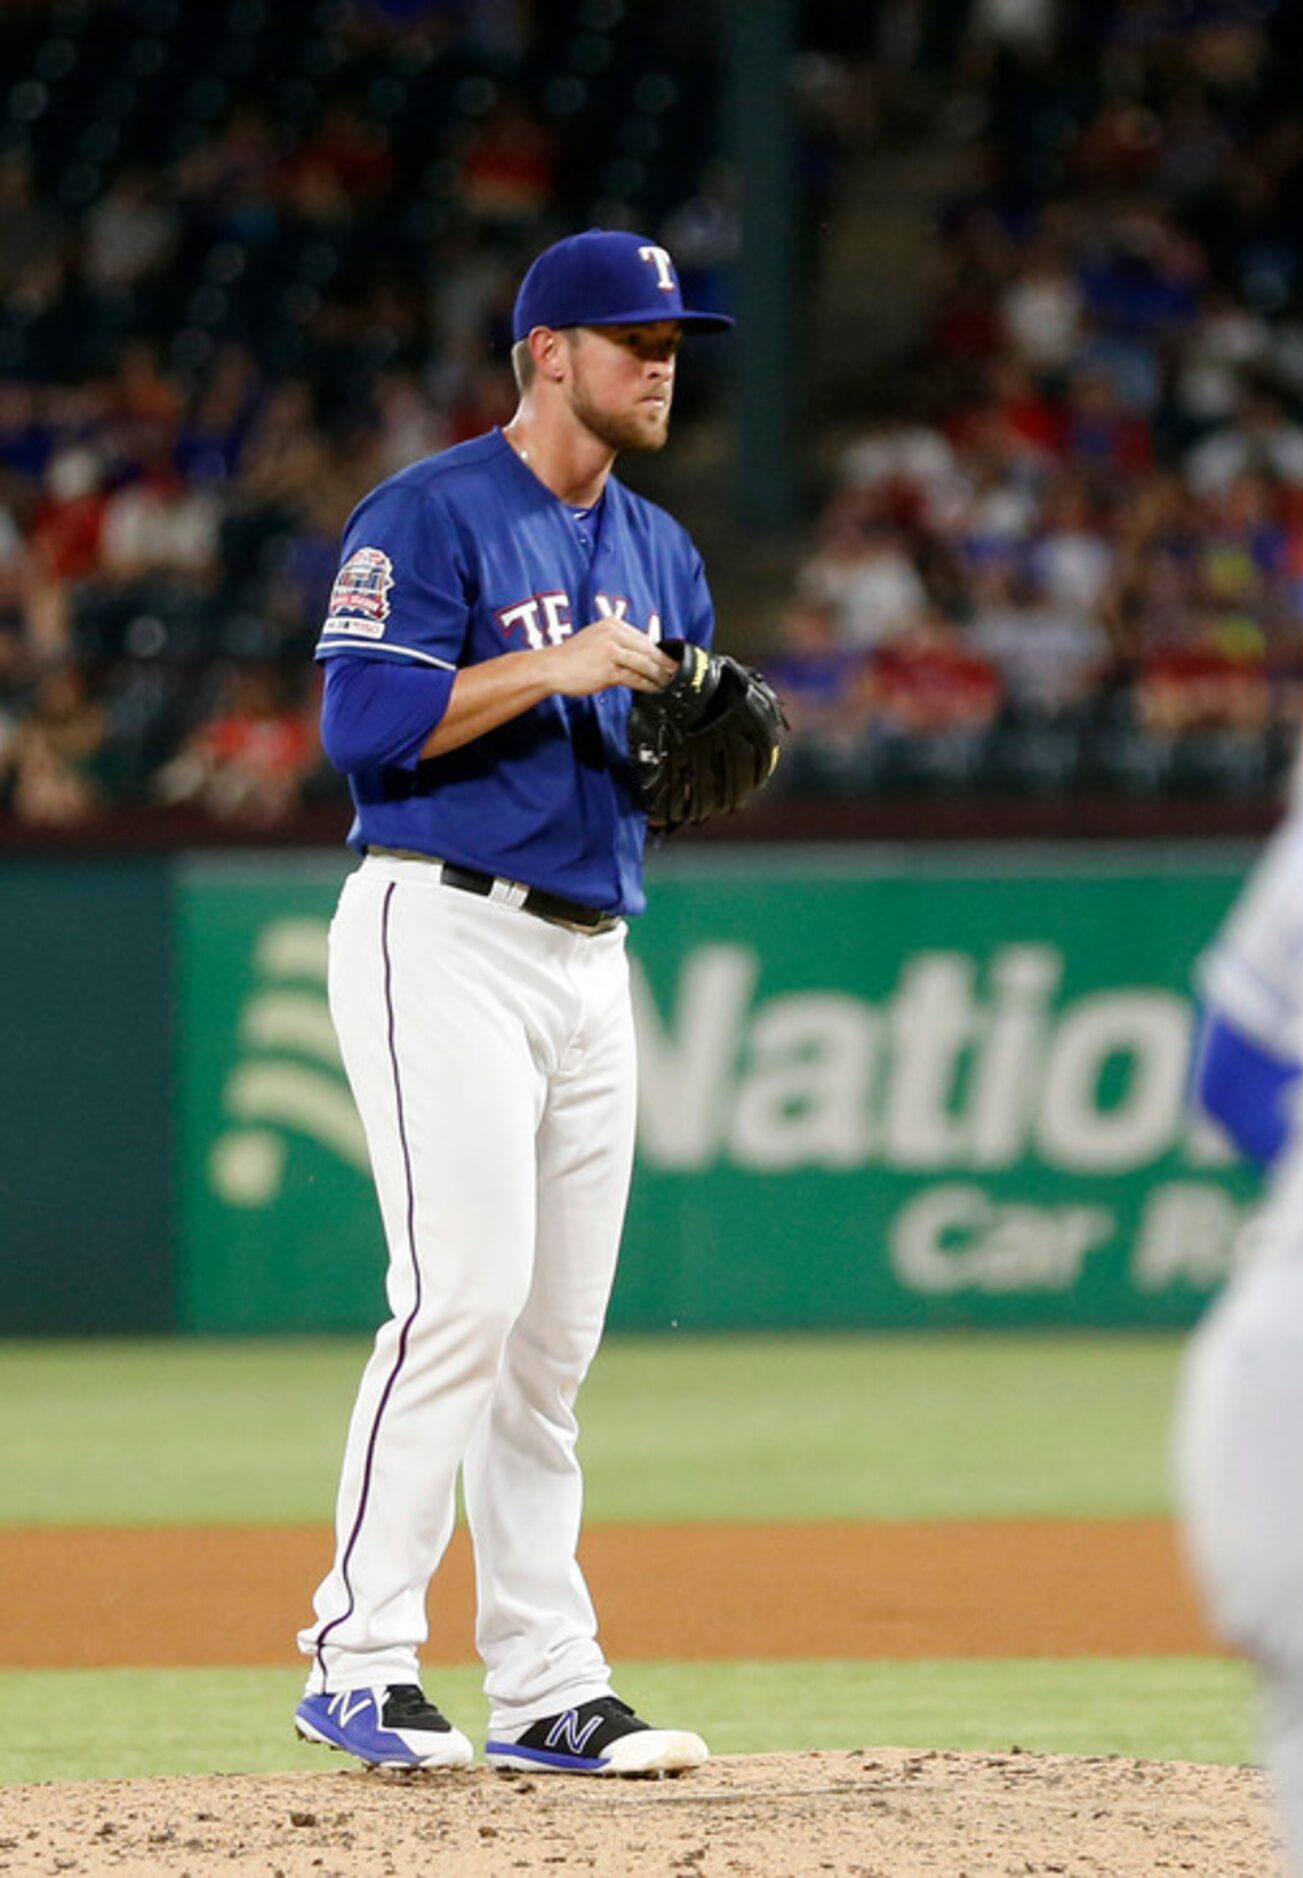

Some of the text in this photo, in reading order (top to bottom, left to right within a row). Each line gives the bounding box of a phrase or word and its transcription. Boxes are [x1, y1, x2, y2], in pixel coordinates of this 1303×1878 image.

[638, 245, 675, 293] T
[634, 945, 1236, 1170] Natio
[890, 1184, 1110, 1292] Car
